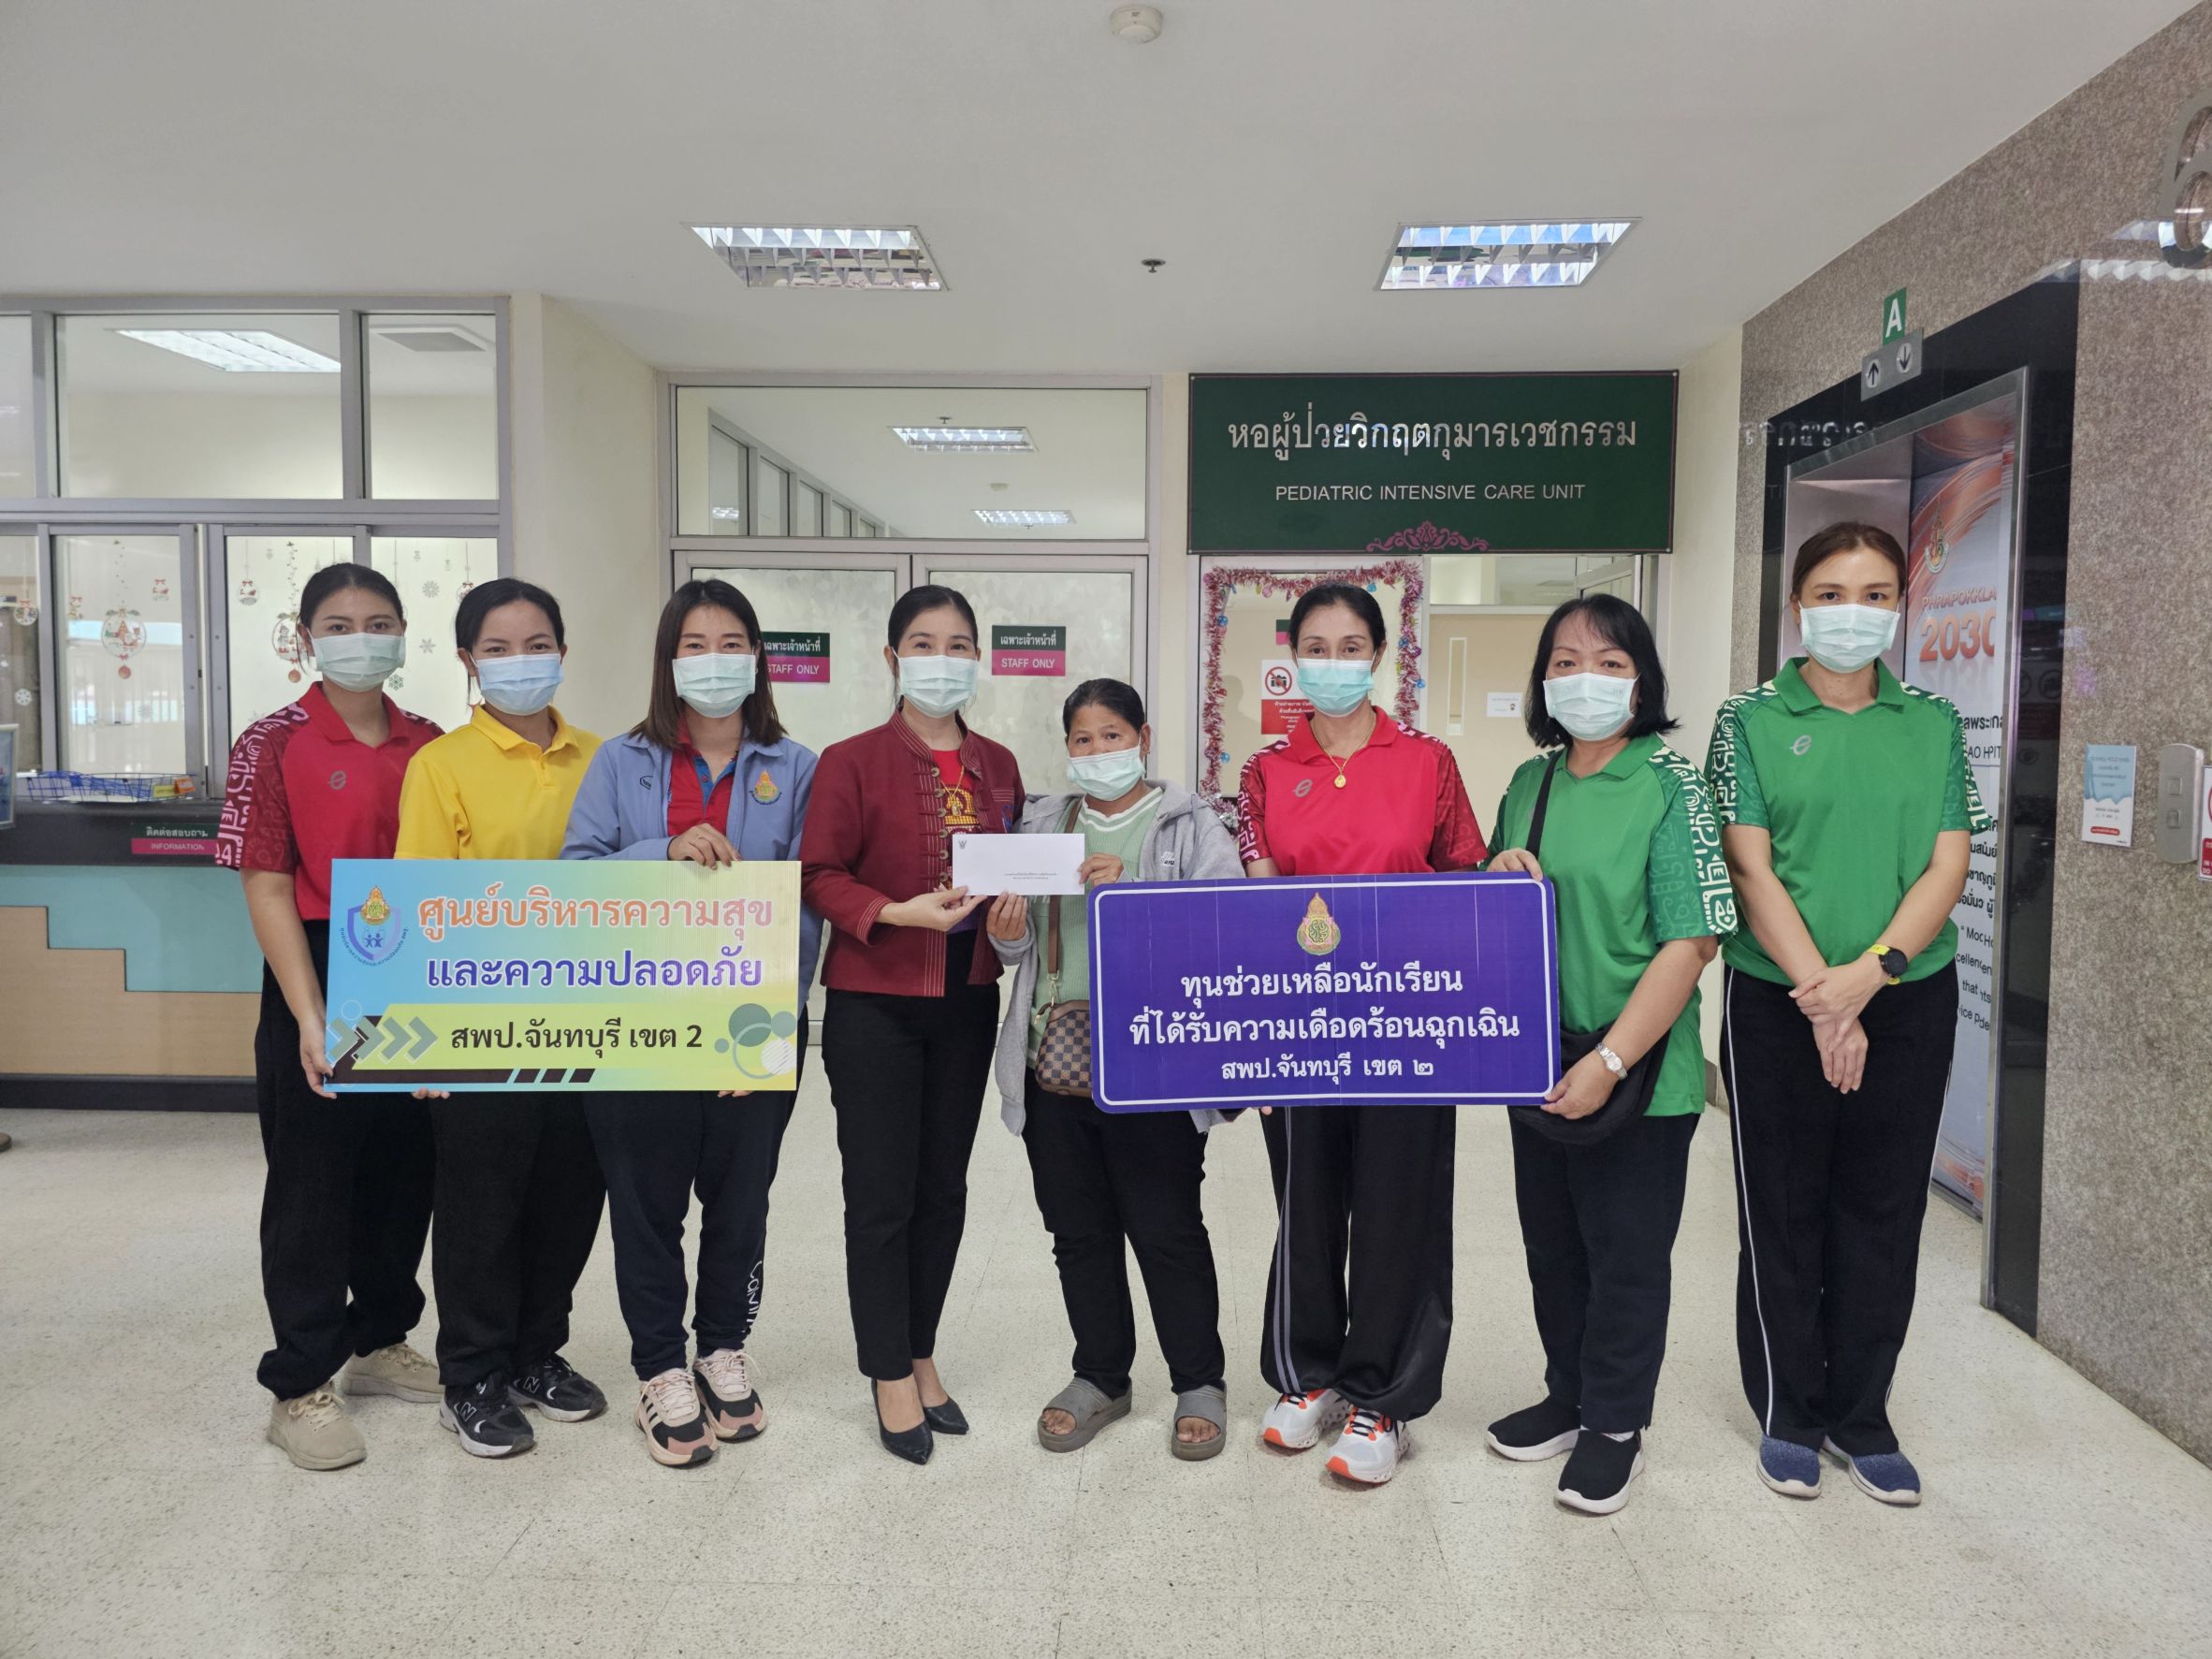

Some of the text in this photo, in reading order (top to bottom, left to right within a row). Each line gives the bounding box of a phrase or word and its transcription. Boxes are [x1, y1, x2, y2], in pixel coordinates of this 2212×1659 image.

[1885, 298, 1902, 338] A
[1228, 402, 1637, 461] หอผู้ป่วยวิกฤตกุมารเวชกรรม
[1275, 484, 1586, 502] PEDIATRIC INTENSIVE CARE UNIT
[764, 636, 821, 652] เฉพาะเจ้าหน้าที่
[1000, 630, 1057, 648] เฉพาะเจ้าหน้าที่
[767, 663, 820, 675] STAFF ONLY
[1001, 658, 1055, 669] STAFF ONLY
[418, 882, 774, 941] ศูนย์บริหารความสุข
[427, 945, 764, 988] และความปลอดภัย
[1181, 960, 1463, 1008] ทุนช่วยเหลือนักเรียน
[1962, 980, 1978, 996] that
[451, 1016, 703, 1058] สพป.จันทบุรี เขต 2
[1128, 1006, 1521, 1049] ที่ได้รับความเดือดร้อนฉุกเฉิน
[1221, 1053, 1434, 1084] สพป.จันทบุรี เขต ๒
